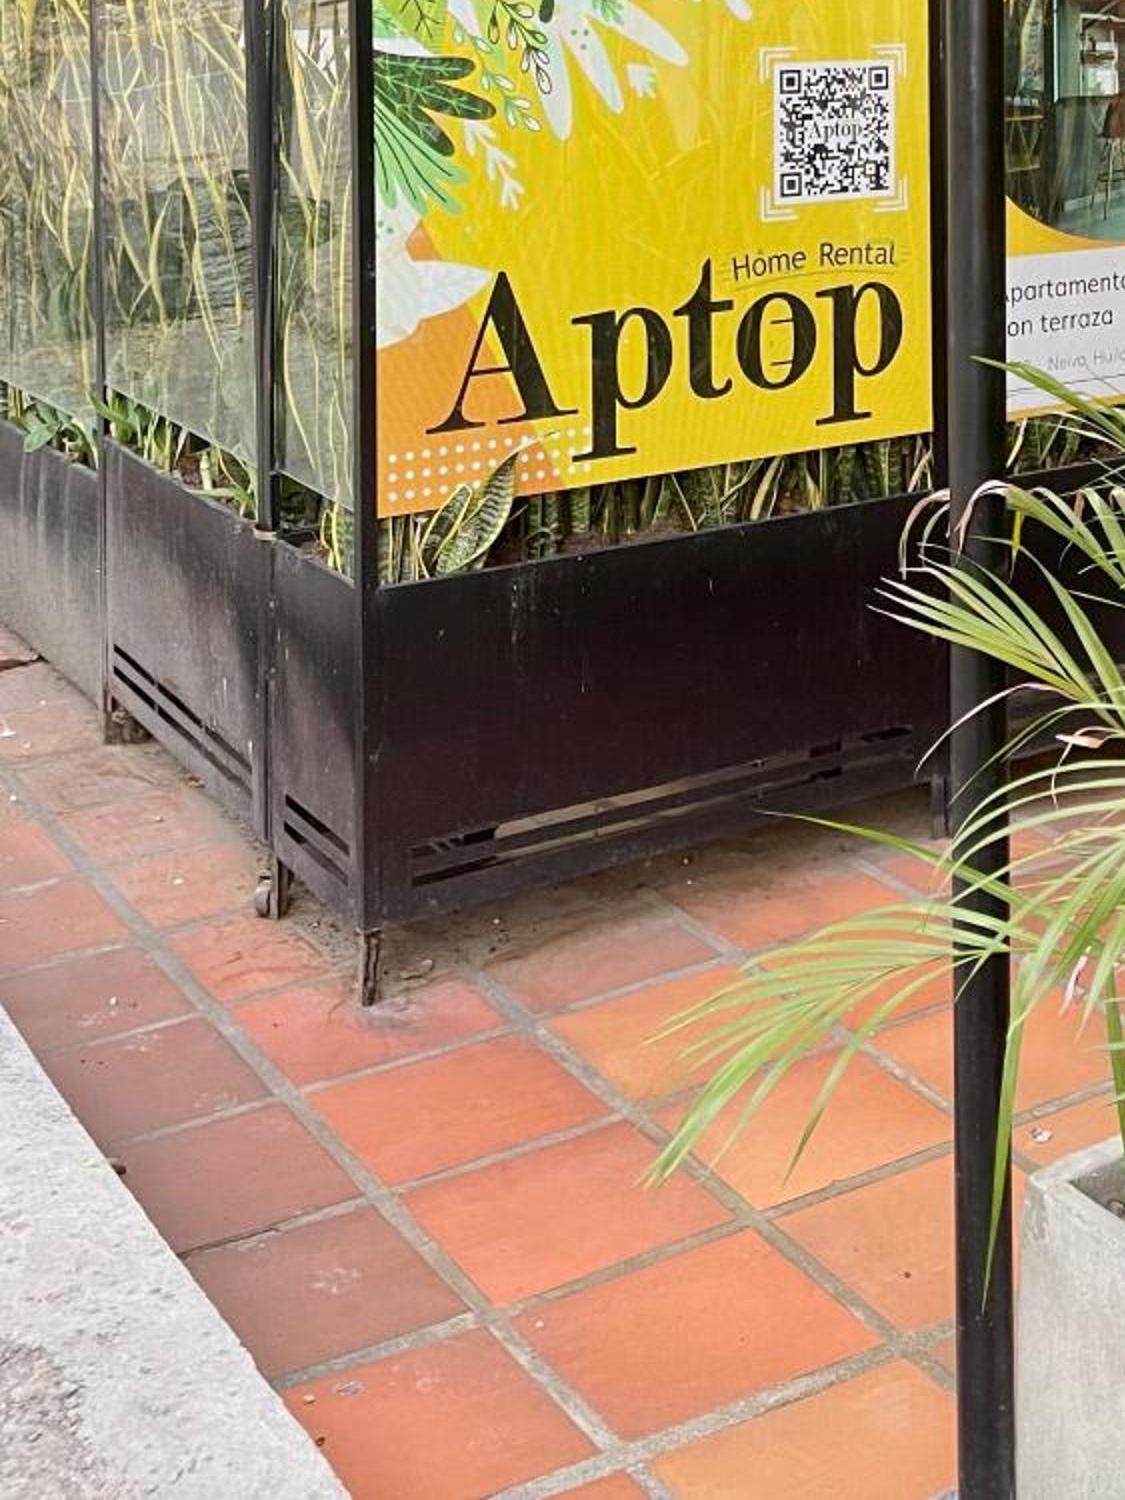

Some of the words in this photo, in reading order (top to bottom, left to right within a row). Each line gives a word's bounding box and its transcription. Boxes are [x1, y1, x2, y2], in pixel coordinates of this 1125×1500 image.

[809, 120, 863, 146] Aptop
[733, 250, 807, 282] Home
[819, 241, 896, 268] Rental
[1007, 317, 1033, 337] on
[1041, 307, 1114, 334] terraza
[425, 257, 904, 464] Aptop
